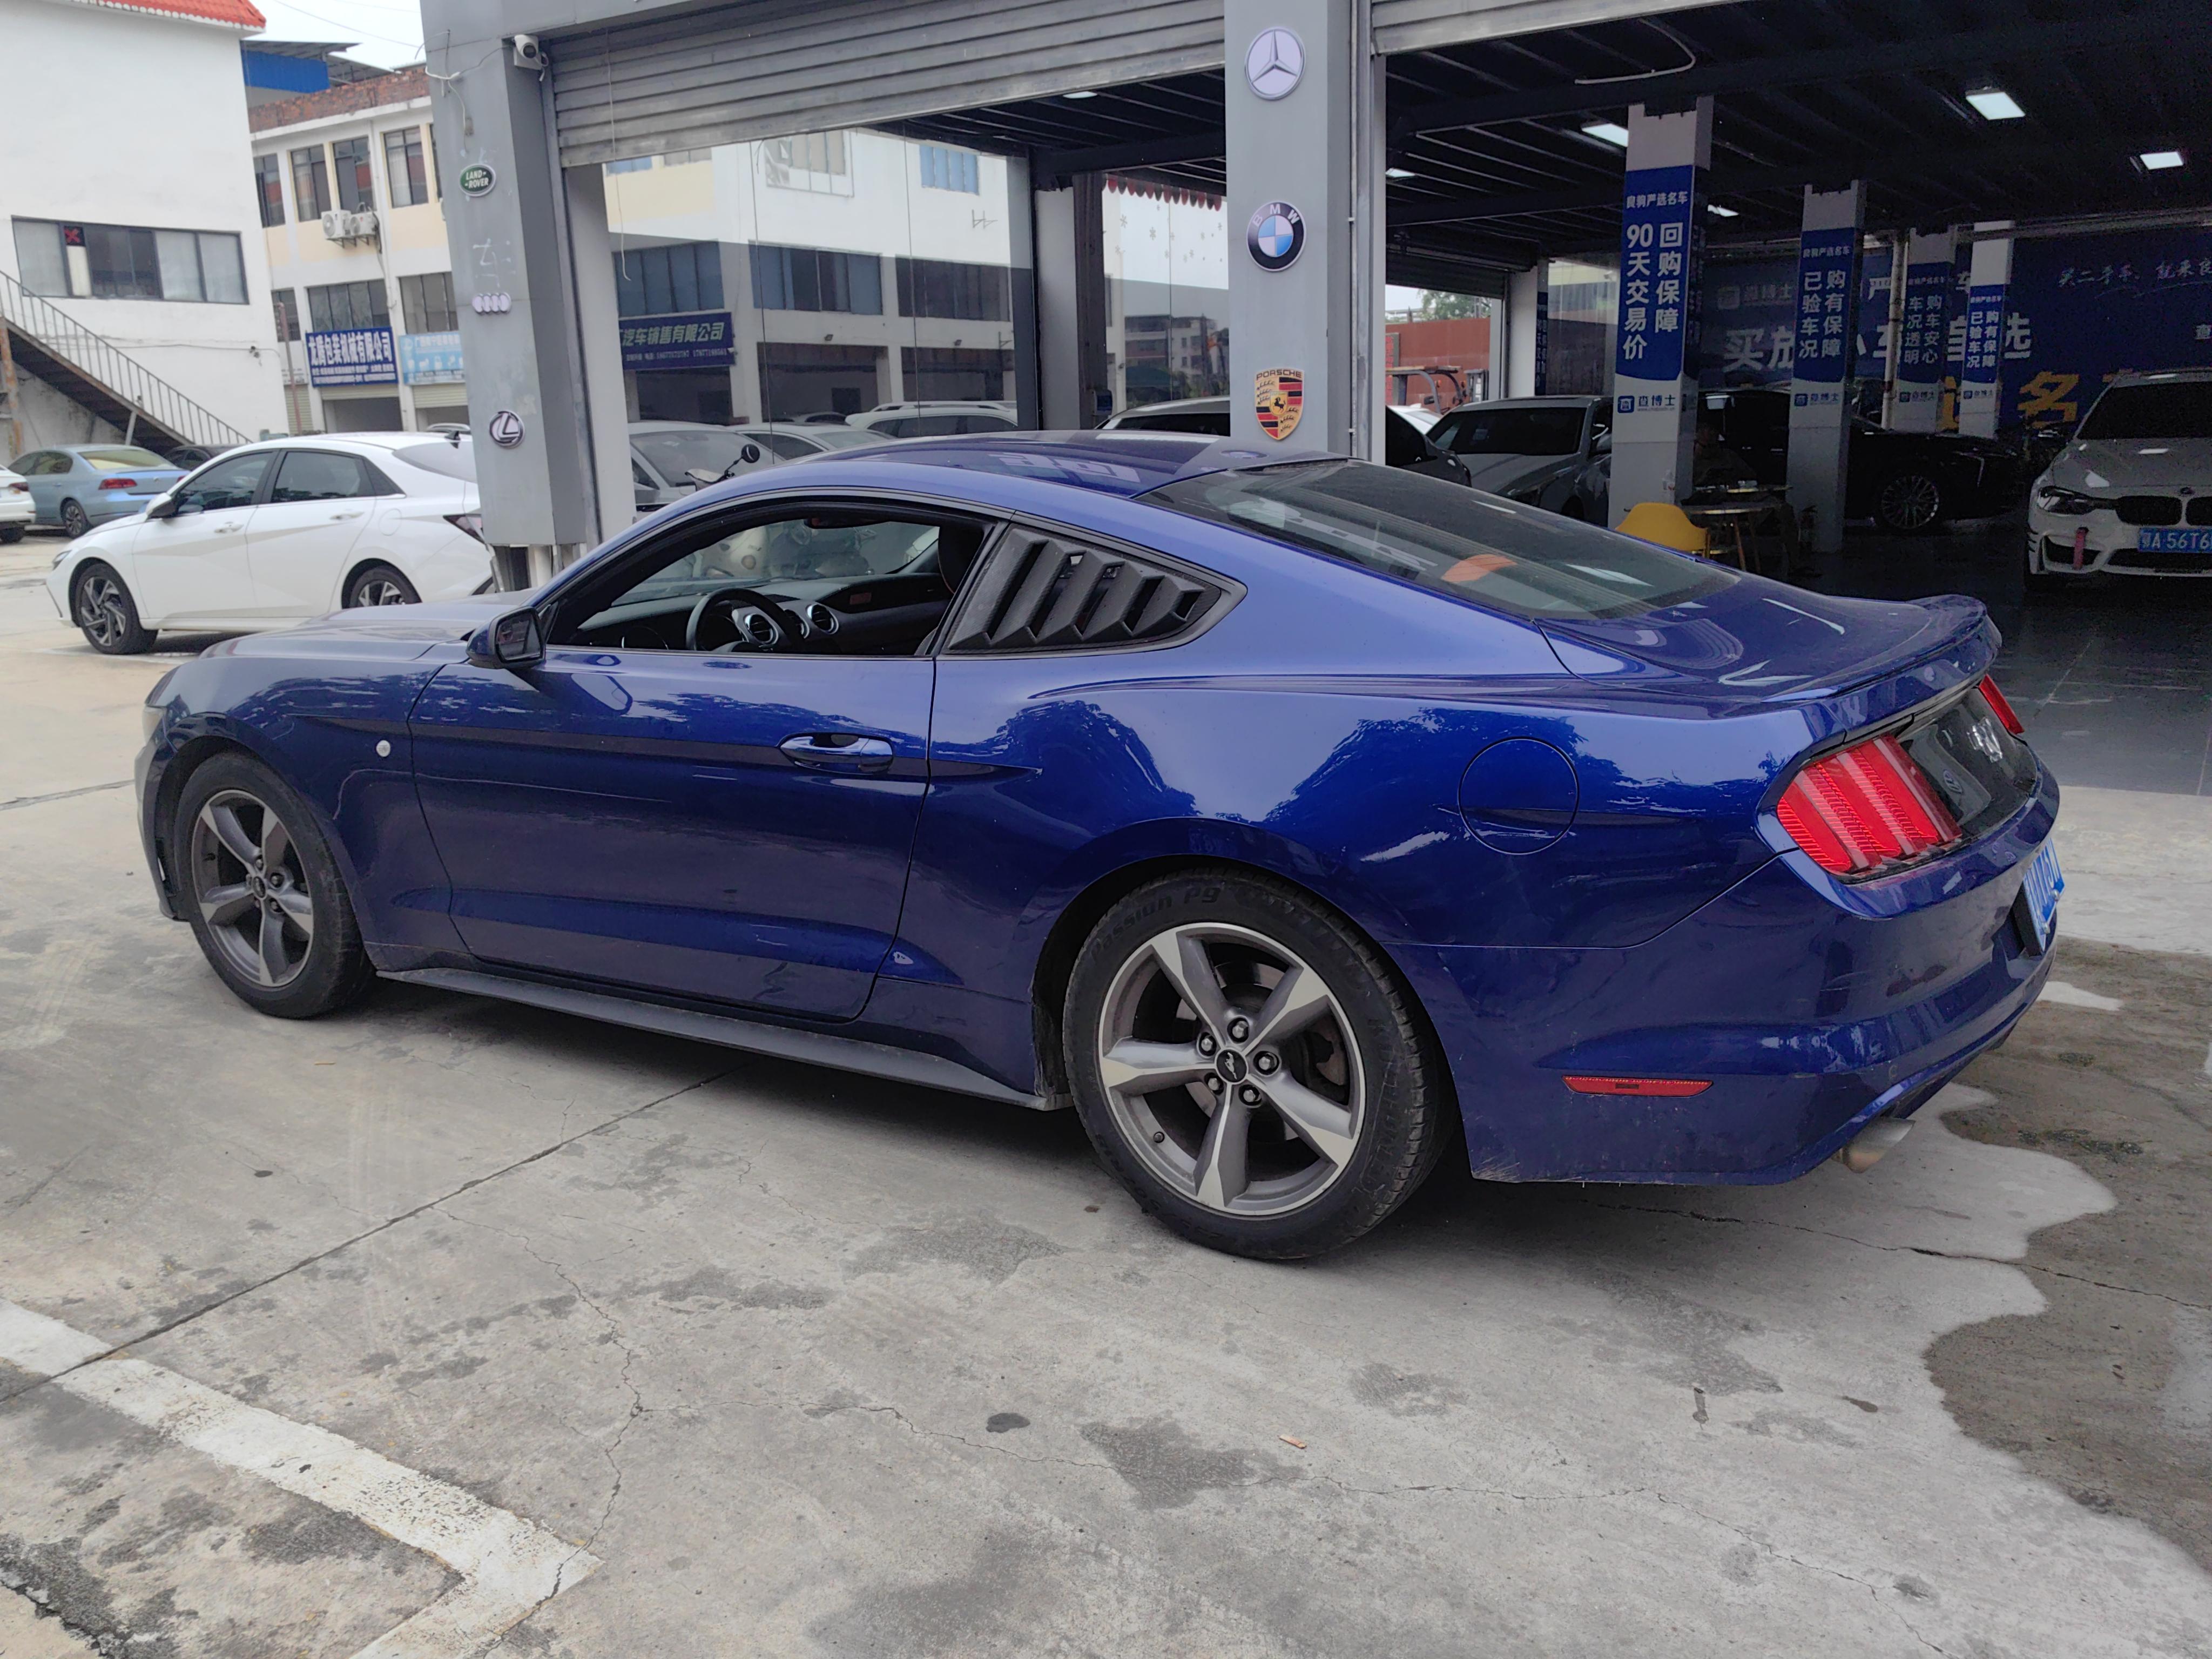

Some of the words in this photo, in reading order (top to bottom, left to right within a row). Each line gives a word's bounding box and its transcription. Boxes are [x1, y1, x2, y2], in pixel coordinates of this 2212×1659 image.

[1252, 203, 1300, 227] BMW
[1655, 222, 1684, 334] 回购保障
[620, 322, 725, 346] 汽车销售有限公司
[1256, 369, 1303, 381] PORSCHE
